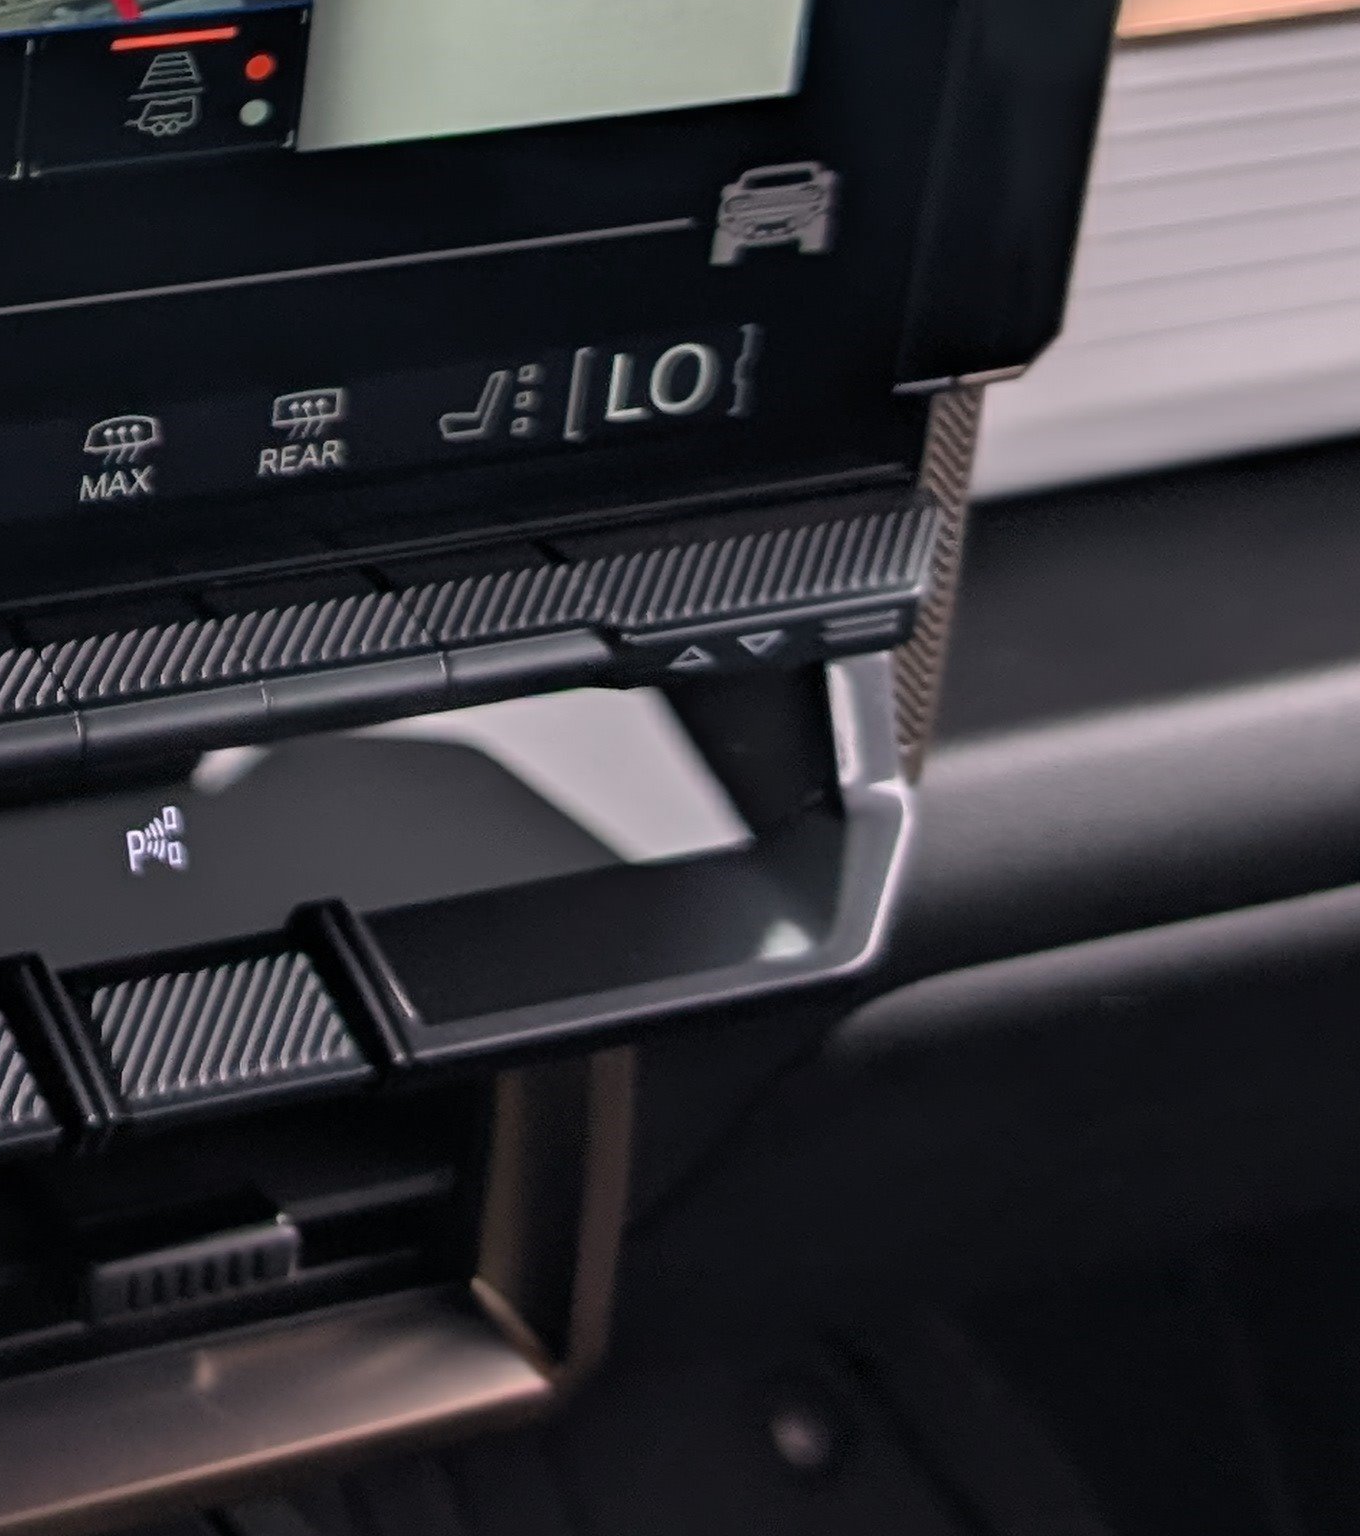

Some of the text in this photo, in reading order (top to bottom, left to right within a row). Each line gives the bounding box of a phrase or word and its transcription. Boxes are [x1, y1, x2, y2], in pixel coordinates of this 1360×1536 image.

[605, 343, 712, 421] LO
[258, 439, 342, 475] REAR
[80, 465, 152, 502] MAX
